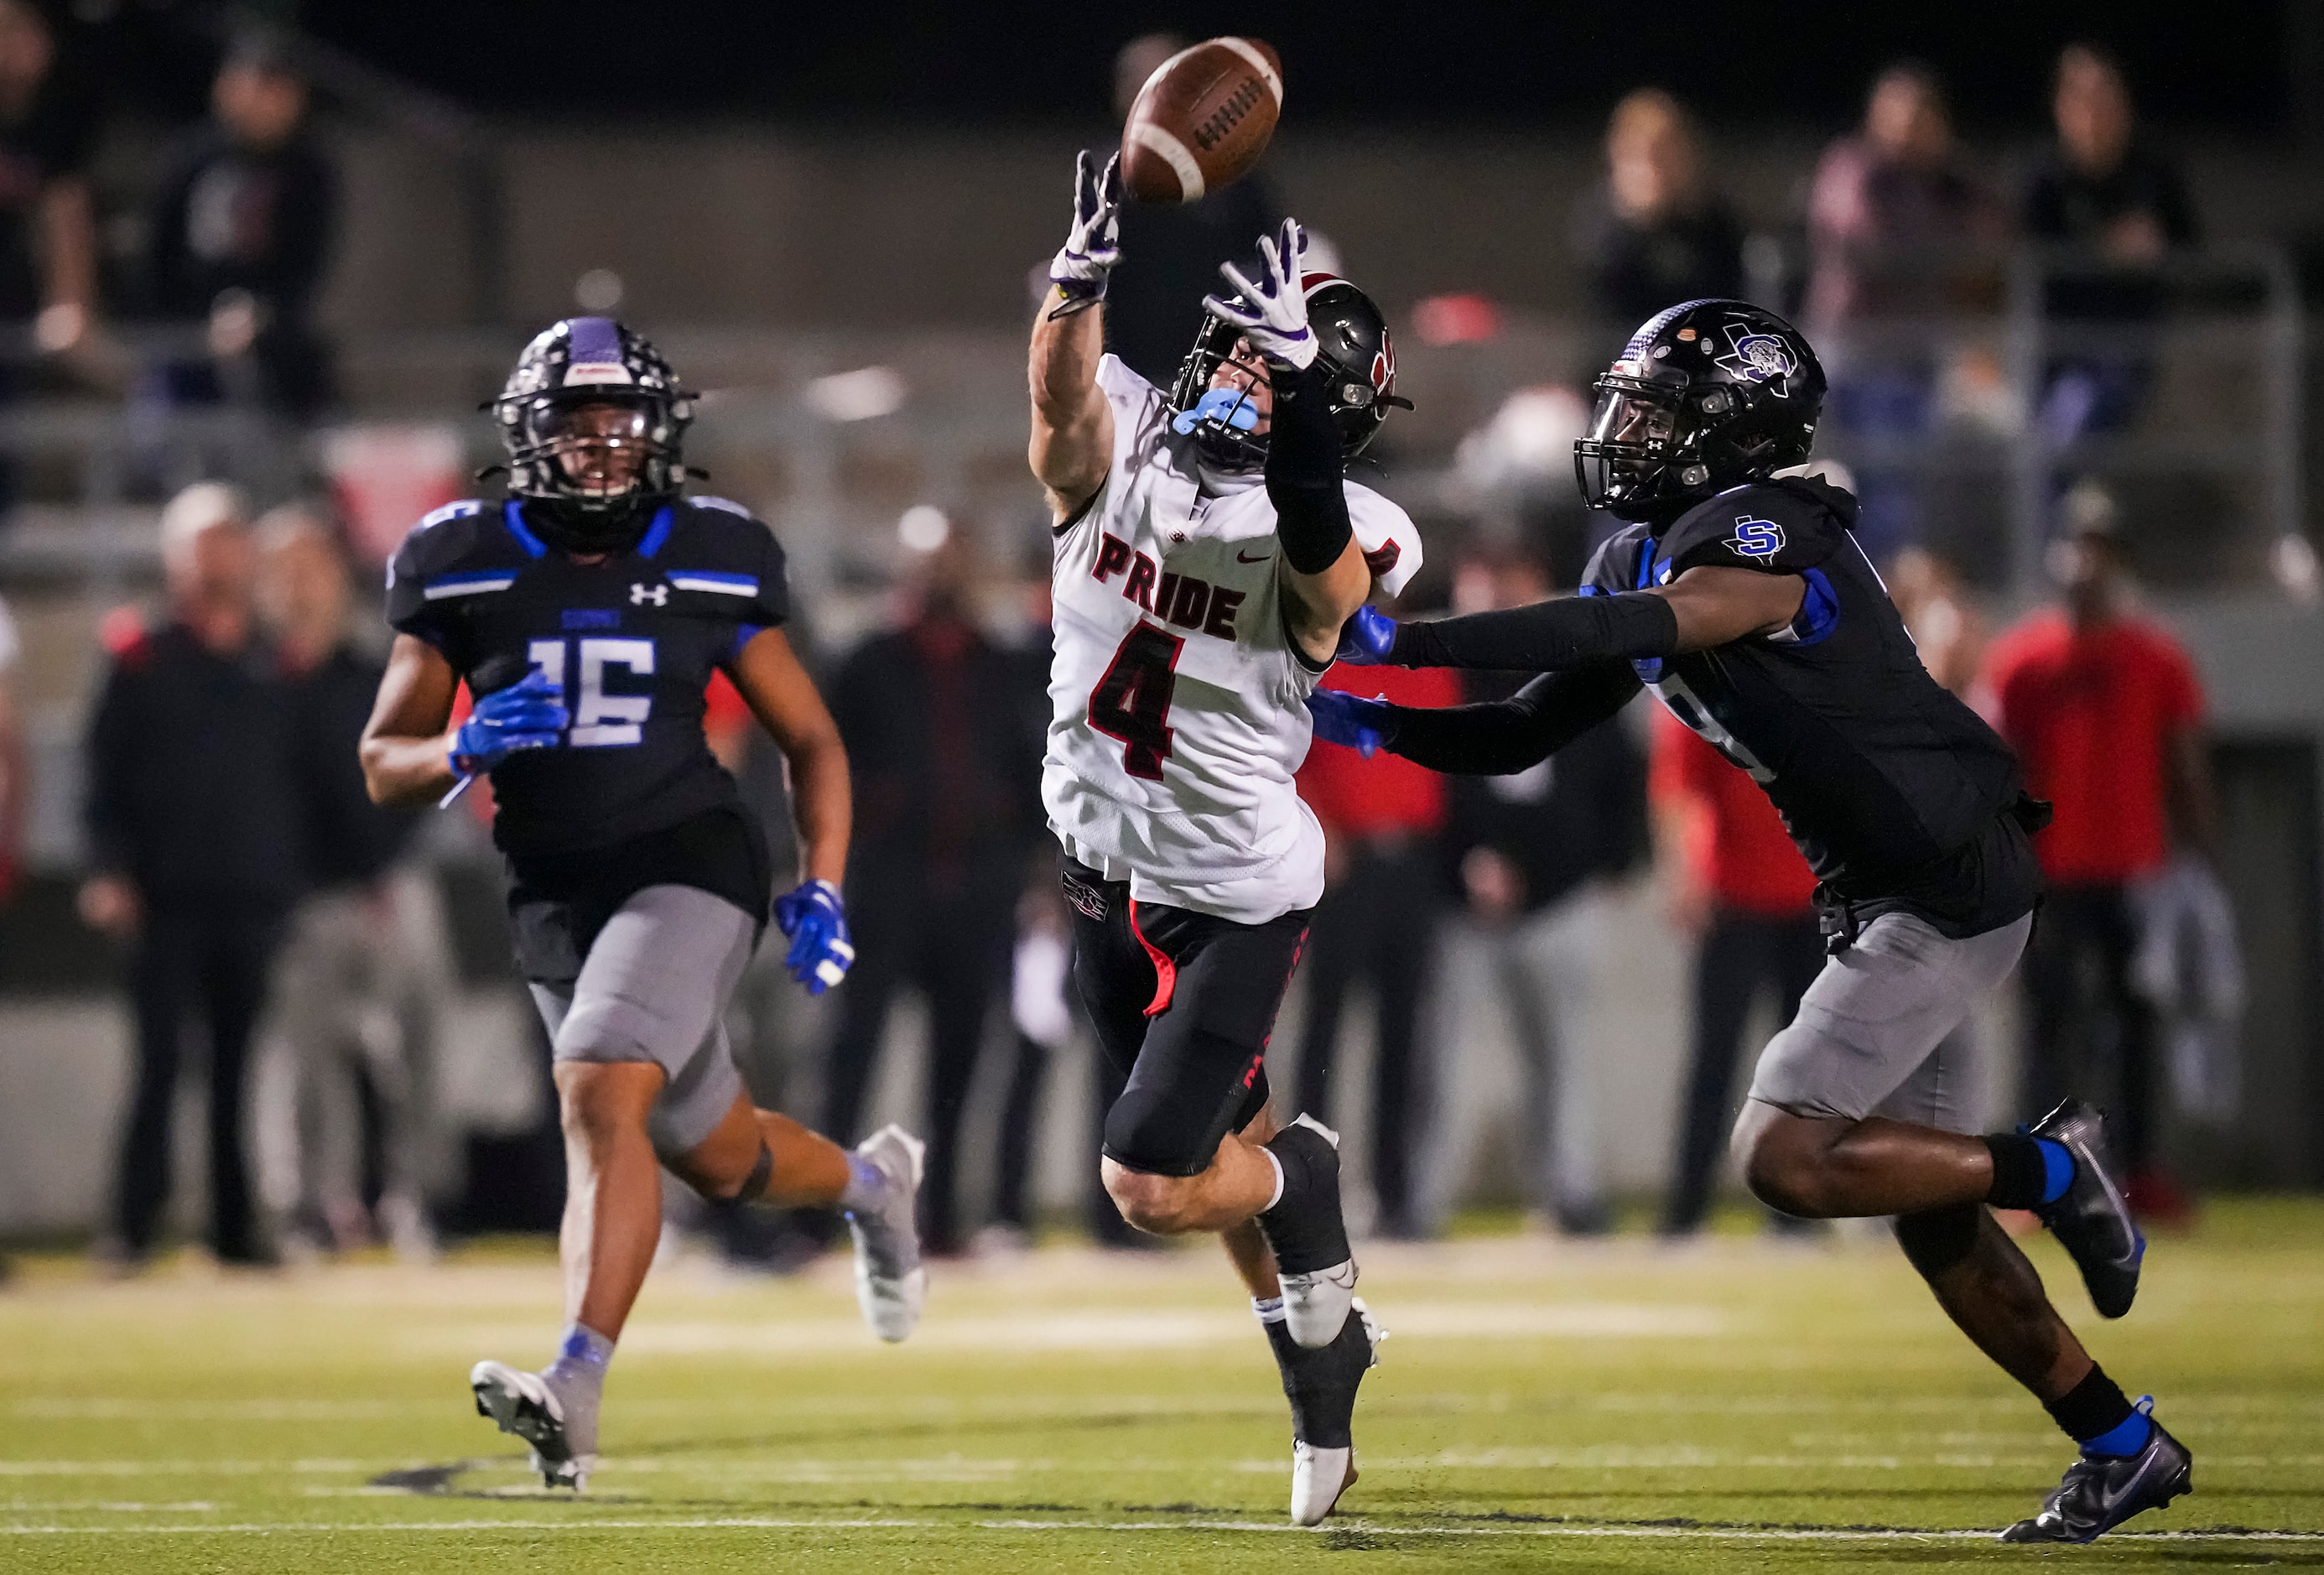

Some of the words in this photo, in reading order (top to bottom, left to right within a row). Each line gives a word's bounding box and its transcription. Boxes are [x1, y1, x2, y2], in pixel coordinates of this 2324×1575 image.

[1091, 532, 1246, 642] PRIDE
[1734, 517, 1781, 558] S
[528, 637, 656, 748] 16
[1088, 619, 1186, 782] 4
